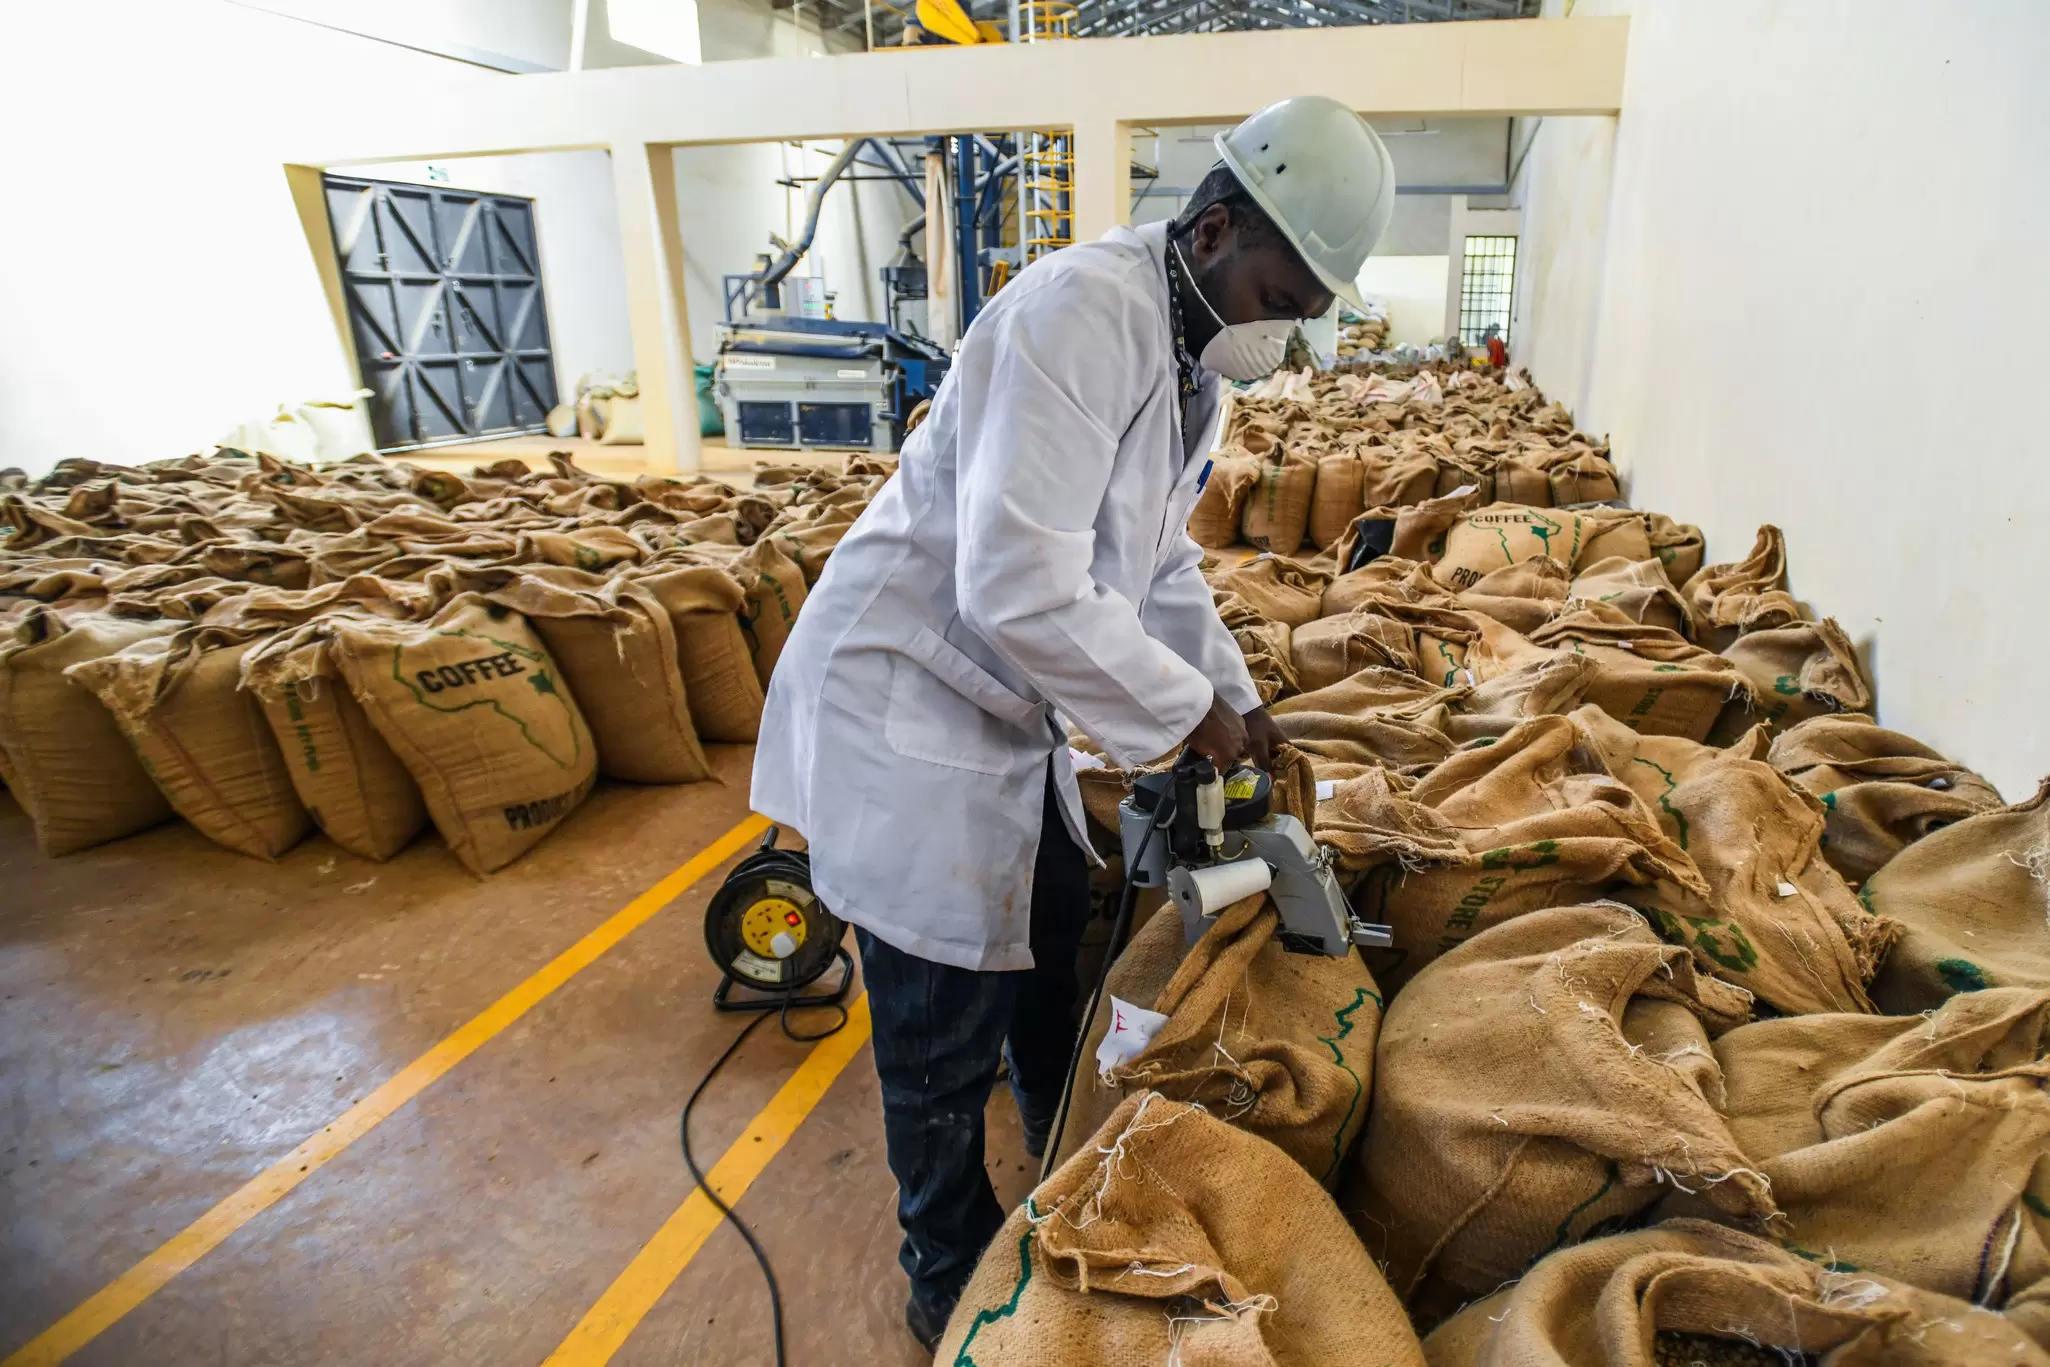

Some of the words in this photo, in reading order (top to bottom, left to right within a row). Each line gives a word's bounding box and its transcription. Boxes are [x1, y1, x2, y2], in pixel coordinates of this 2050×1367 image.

[1475, 514, 1533, 524] COFFEE
[416, 651, 526, 693] COFFEE
[1445, 876, 1507, 930] STORE
